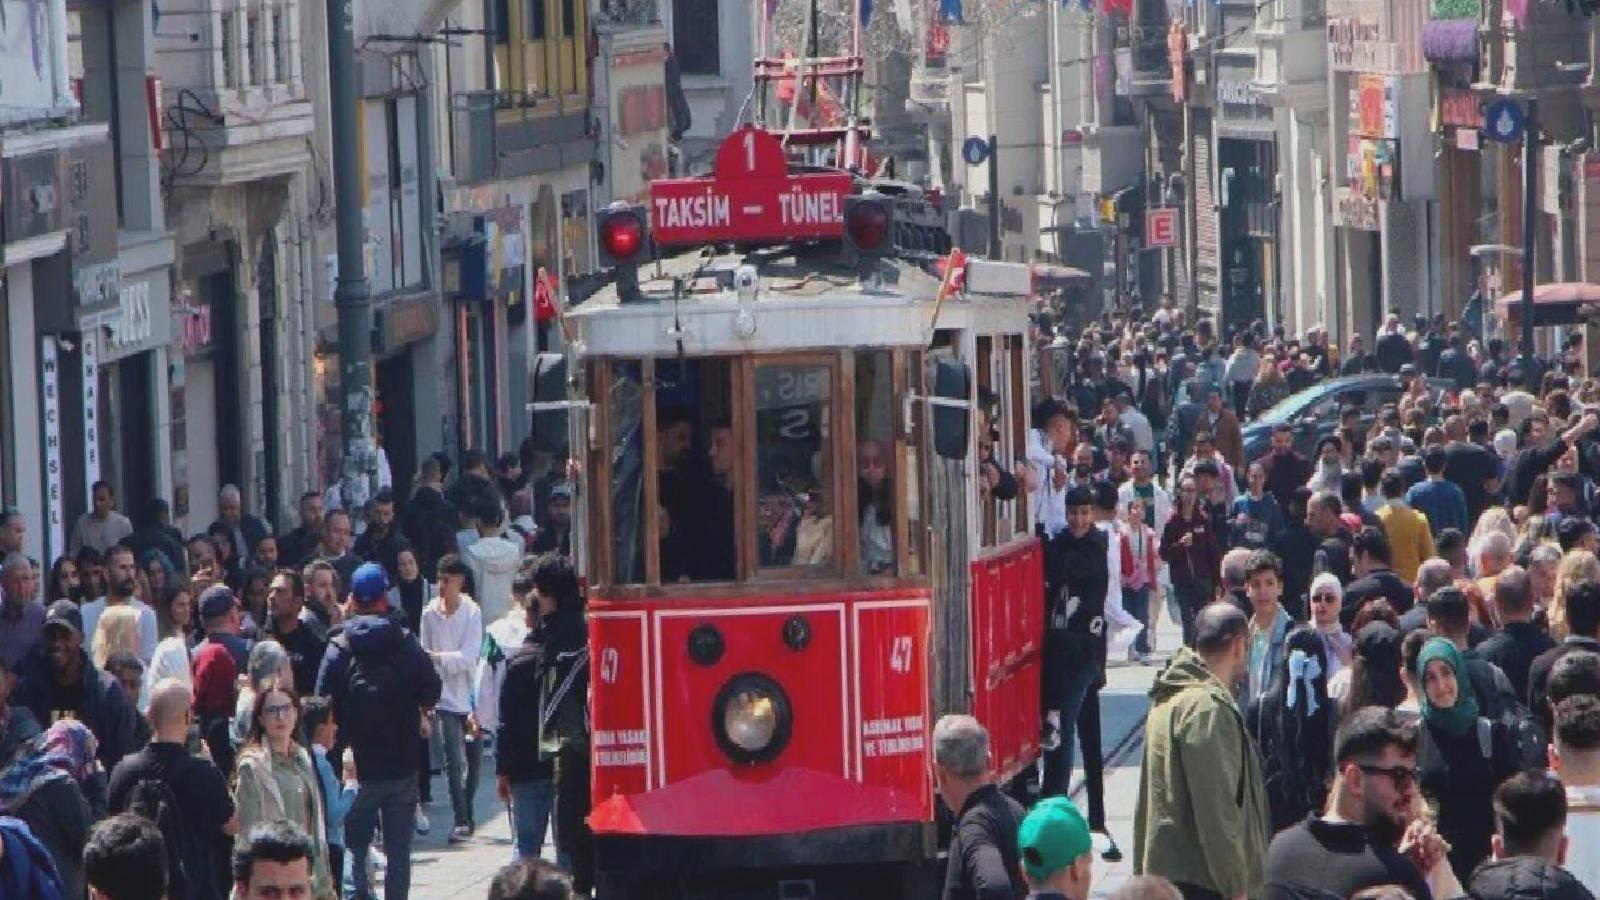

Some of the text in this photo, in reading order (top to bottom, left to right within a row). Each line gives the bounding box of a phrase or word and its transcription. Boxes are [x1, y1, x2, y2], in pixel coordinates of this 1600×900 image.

[743, 131, 757, 171] 1
[655, 186, 730, 227] TAKSİM
[778, 186, 844, 224] TÜNEL
[1156, 217, 1172, 240] E
[44, 360, 60, 525] WECHSEL
[600, 647, 620, 684] 47
[889, 636, 913, 673] 47
